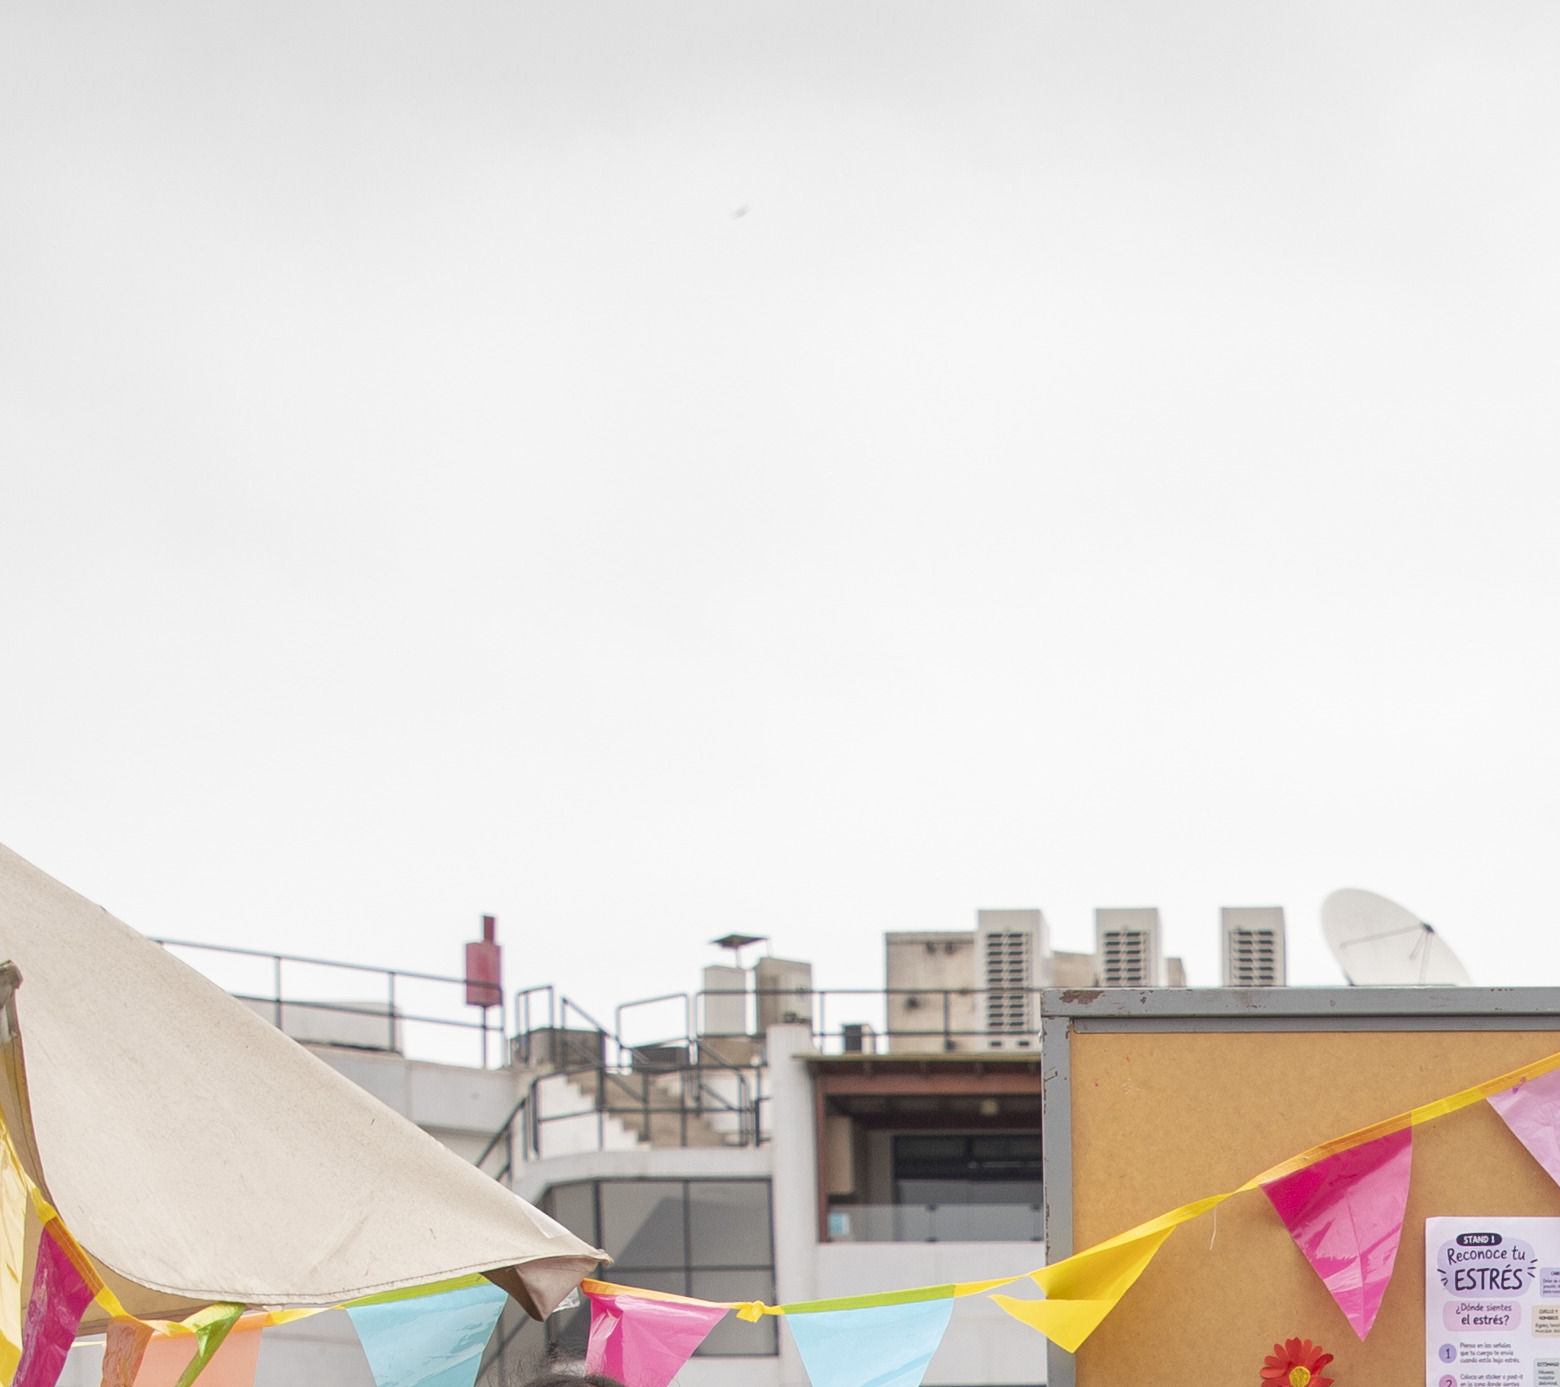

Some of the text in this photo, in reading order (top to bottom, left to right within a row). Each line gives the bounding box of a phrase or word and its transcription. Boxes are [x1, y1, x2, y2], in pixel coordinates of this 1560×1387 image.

[1463, 1235, 1488, 1245] STAND
[1447, 1246, 1526, 1266] Reconoce tu
[1454, 1264, 1523, 1291] ESTRÉS
[1455, 1303, 1512, 1314] ¿Dónde sientes
[1461, 1314, 1510, 1326] el estrés?
